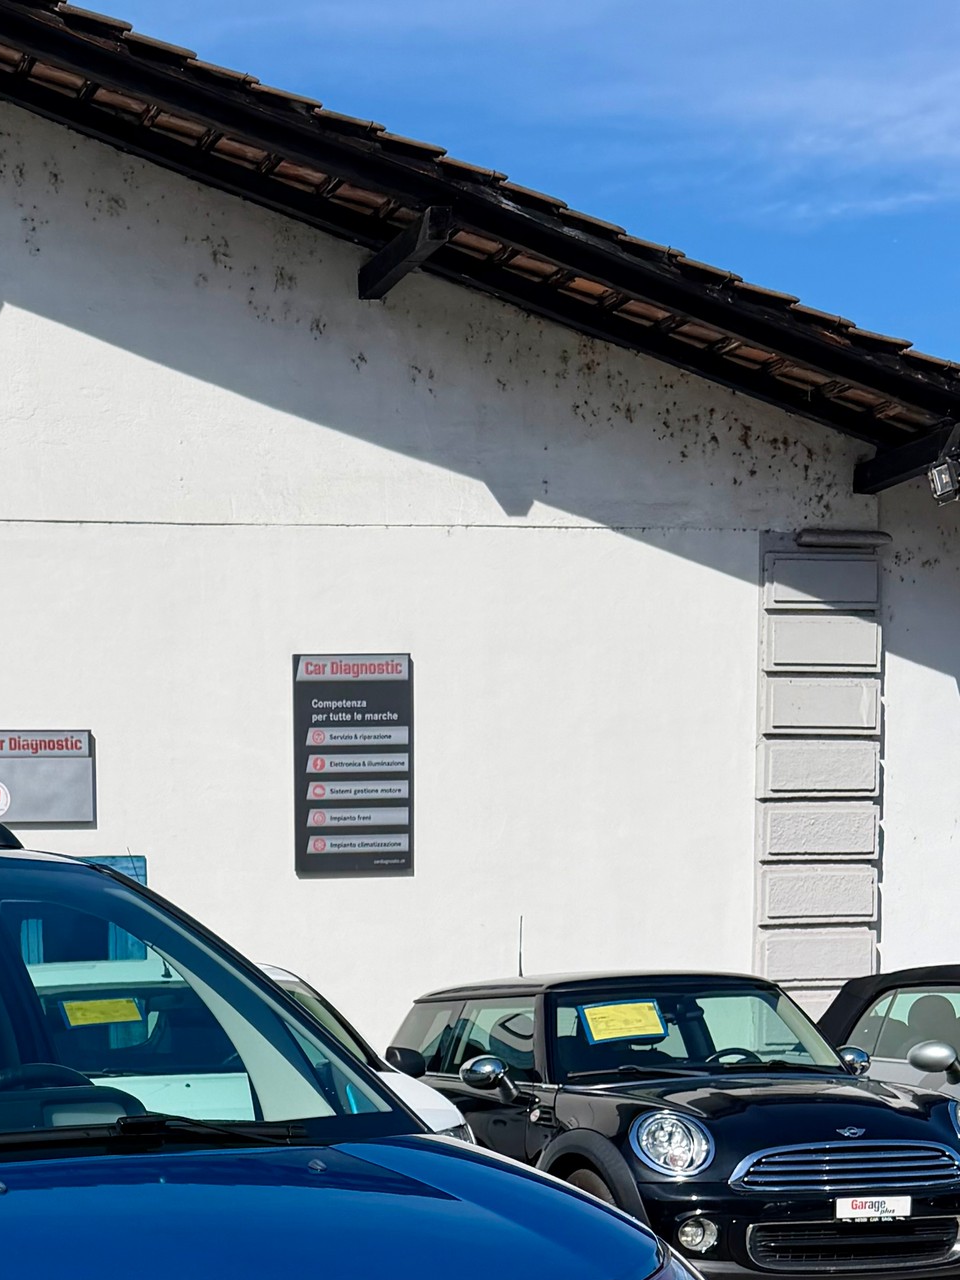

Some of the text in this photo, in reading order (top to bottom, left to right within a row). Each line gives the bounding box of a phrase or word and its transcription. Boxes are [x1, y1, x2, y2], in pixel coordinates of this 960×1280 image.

[304, 659, 403, 678] Car Diagnostic
[311, 698, 367, 710] Competenza
[311, 711, 399, 723] per tutte le marche
[359, 733, 392, 741] riparazione
[8, 735, 83, 754] Diagnostic
[329, 760, 361, 768] Elettronica
[353, 788, 379, 796] gestione
[329, 815, 357, 823] Impianto
[329, 841, 402, 850] Impianto climatizzazione
[851, 1199, 886, 1212] Garage
[880, 1207, 896, 1215] plus
